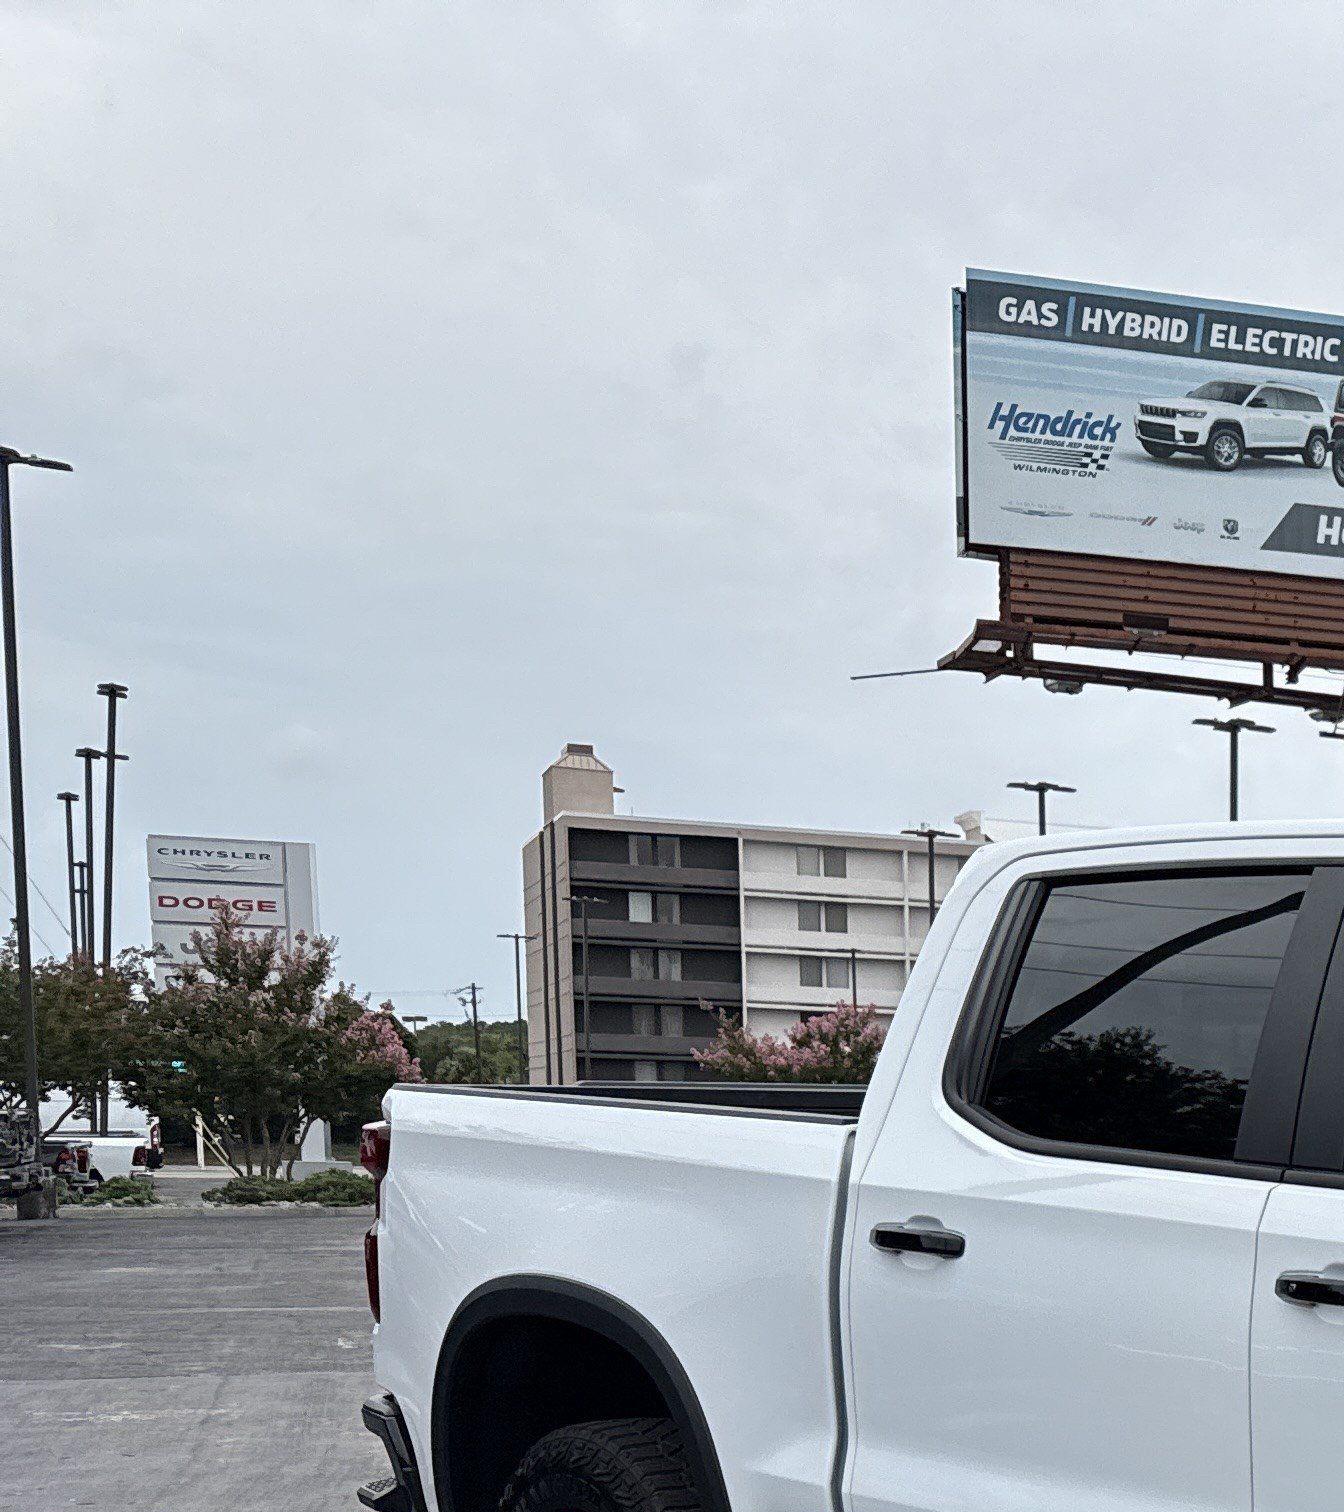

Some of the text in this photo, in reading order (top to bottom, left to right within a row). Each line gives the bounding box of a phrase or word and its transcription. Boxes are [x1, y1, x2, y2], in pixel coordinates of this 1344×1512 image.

[997, 296, 1060, 328] GAS
[1081, 306, 1189, 344] HYBRID
[1209, 322, 1342, 363] ELECTRIC
[987, 401, 1122, 443] Hendrick
[1013, 462, 1098, 479] WILMINGTON
[157, 847, 272, 861] CHRYSLER
